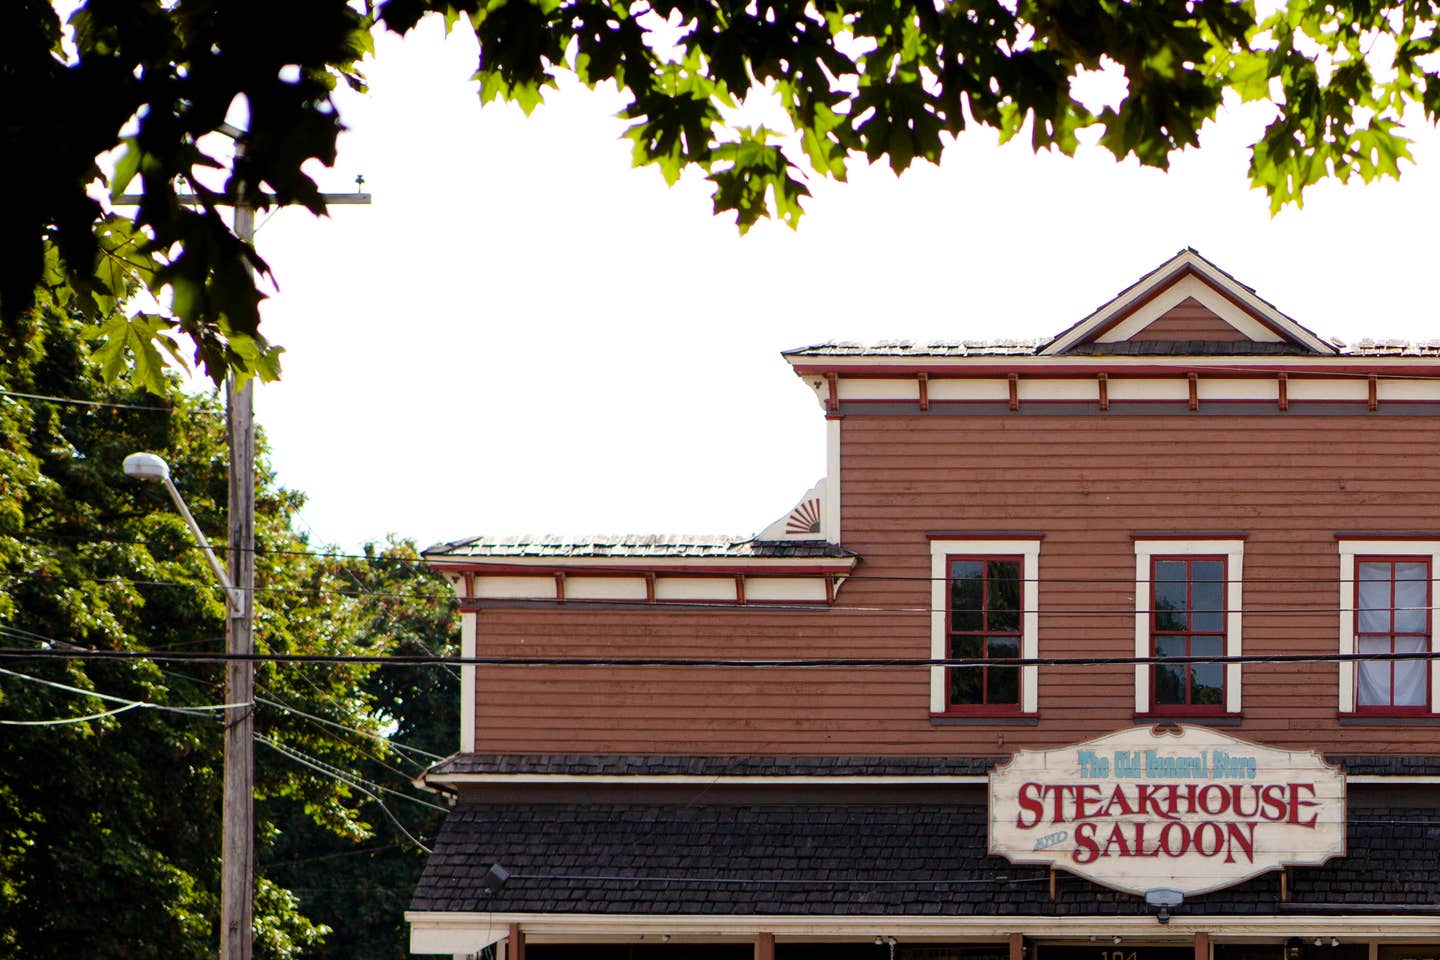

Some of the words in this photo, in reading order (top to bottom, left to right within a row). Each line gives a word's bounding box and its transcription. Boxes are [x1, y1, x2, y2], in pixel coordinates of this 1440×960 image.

[1078, 751, 1109, 778] The
[1114, 751, 1141, 778] Old
[1145, 751, 1209, 778] General
[1212, 751, 1257, 779] Store
[1016, 781, 1323, 830] STEAKHOUSE
[1033, 830, 1069, 851] AND
[1072, 820, 1259, 865] SALOON
